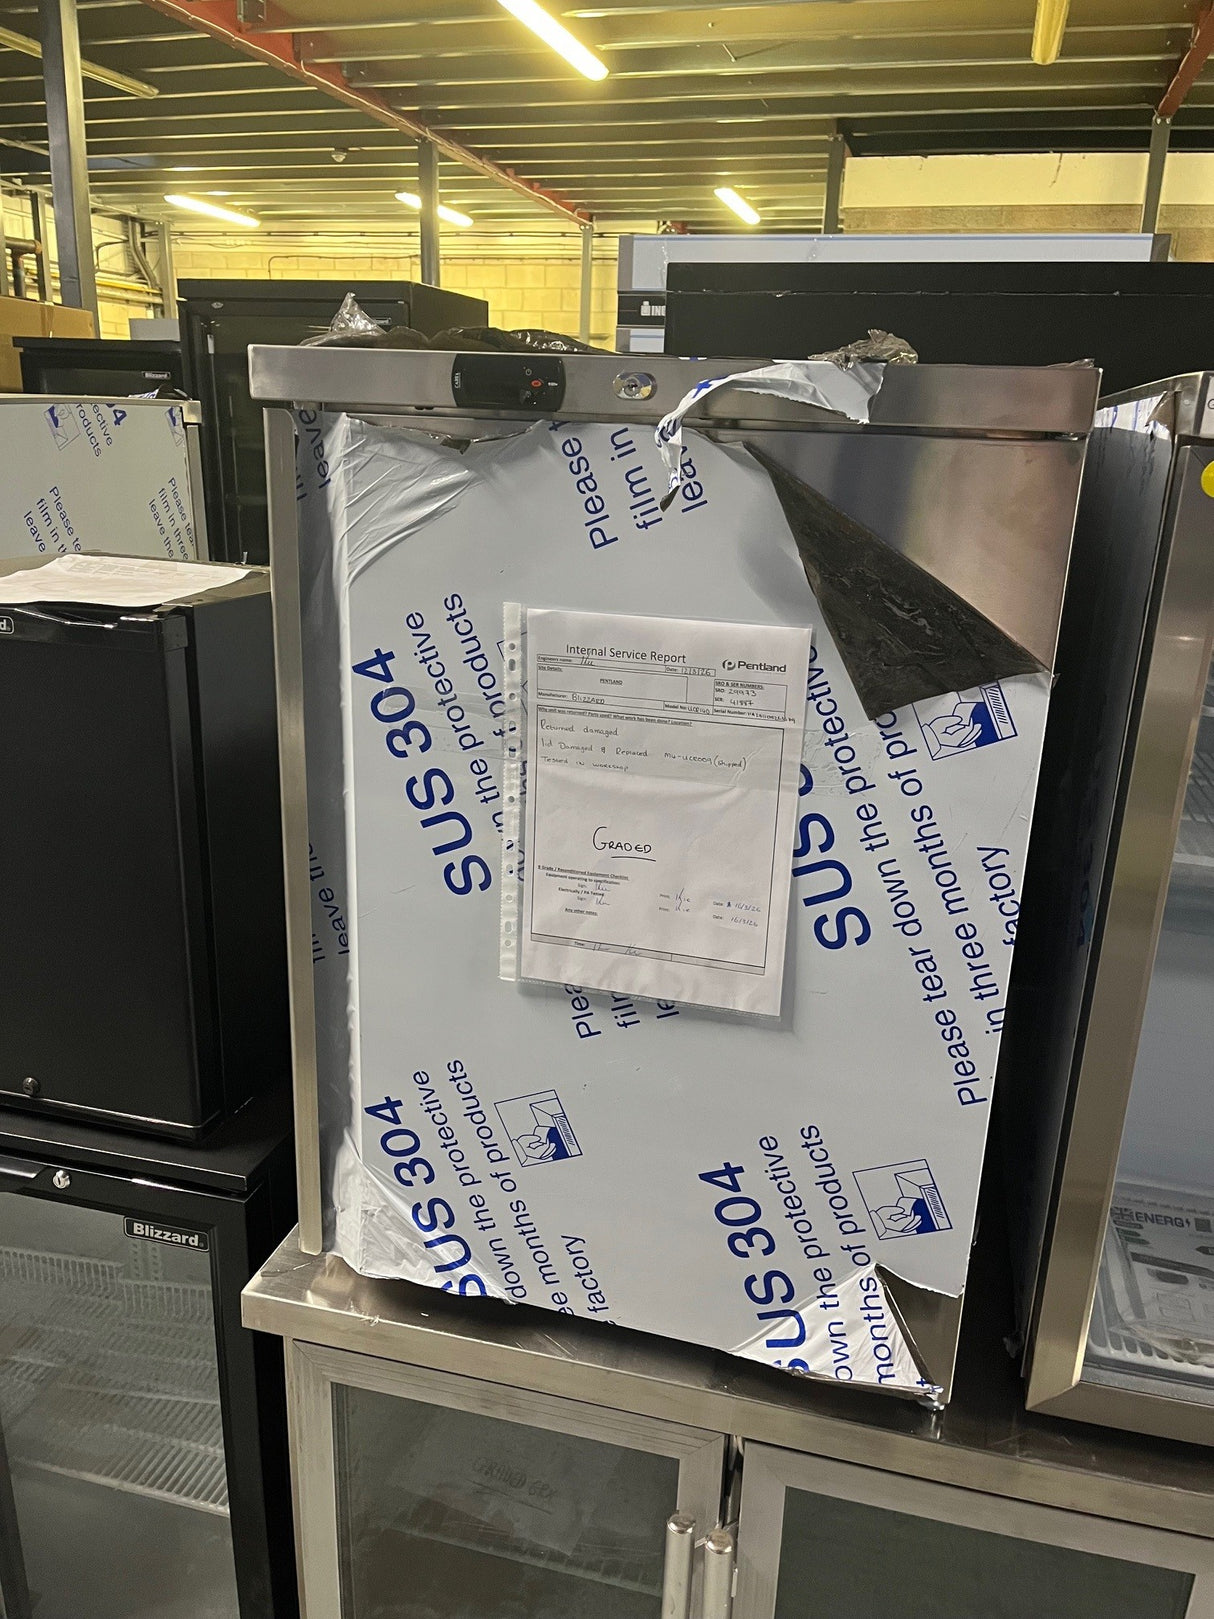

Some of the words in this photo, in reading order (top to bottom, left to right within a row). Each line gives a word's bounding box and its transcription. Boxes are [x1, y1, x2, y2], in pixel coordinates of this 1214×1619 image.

[90, 403, 113, 447] ective
[611, 427, 636, 461] in
[36, 498, 53, 527] film
[49, 525, 60, 544] in
[49, 486, 74, 536] Please
[158, 487, 172, 512] film
[168, 512, 177, 527] in
[167, 477, 187, 521] Please
[562, 437, 618, 549] Please
[625, 465, 662, 530] film
[23, 510, 46, 552] leave
[149, 499, 165, 535] leave
[163, 535, 174, 559] the
[405, 611, 484, 750] protective
[444, 593, 505, 718] products
[566, 644, 607, 657] Internal
[609, 648, 648, 660] Service
[650, 651, 686, 664] Report
[737, 660, 787, 673] Pentland
[352, 648, 432, 758] 304
[470, 758, 500, 804] the
[887, 769, 923, 798] of
[405, 768, 492, 895] SUS
[592, 826, 652, 853] GRADED
[856, 802, 890, 853] the
[792, 812, 872, 950] SUS
[911, 804, 969, 916] months
[318, 887, 350, 955] leave
[877, 858, 922, 937] down
[908, 947, 947, 1002] tear
[955, 923, 999, 1001] three
[985, 1008, 1006, 1034] in
[935, 1009, 988, 1106] Please
[364, 1095, 435, 1187] 304
[413, 1070, 482, 1187] protective
[447, 1058, 509, 1164] products
[490, 1171, 517, 1193] of
[698, 1162, 776, 1258] 304
[759, 1136, 830, 1259] protective
[800, 1125, 866, 1235] products
[133, 1222, 199, 1246] Blizzard
[469, 1194, 496, 1231] the
[510, 1200, 560, 1285] months
[489, 1238, 527, 1299] down
[561, 1235, 609, 1313] factory
[840, 1244, 871, 1267] of
[813, 1267, 840, 1310] the
